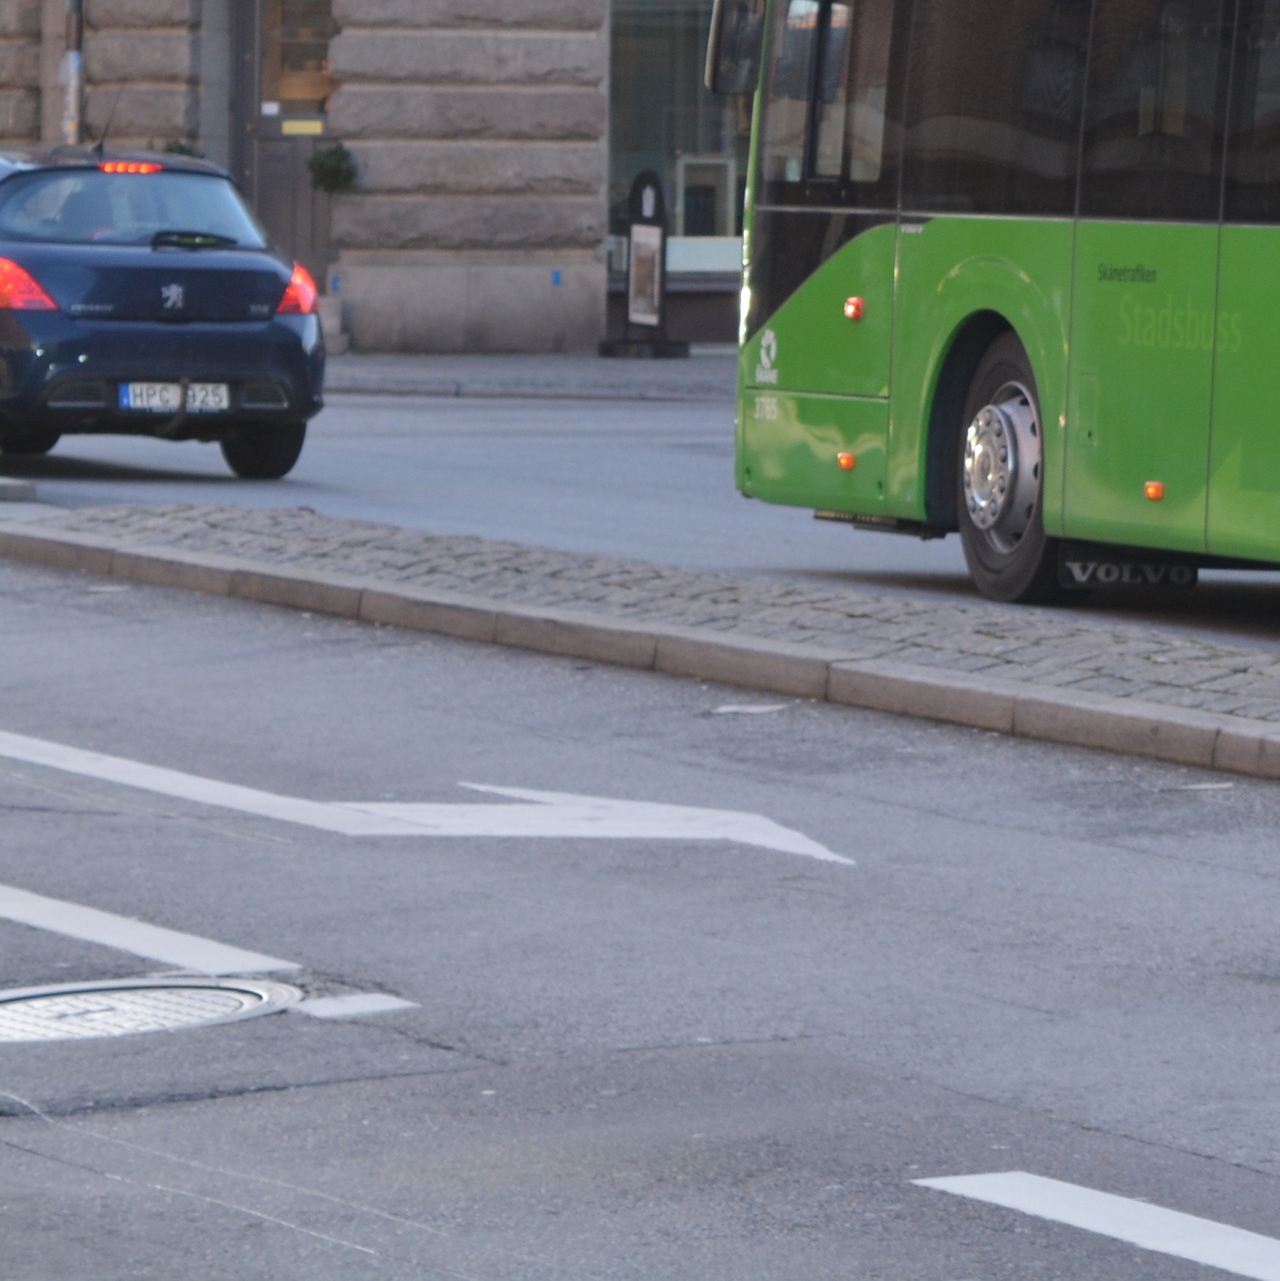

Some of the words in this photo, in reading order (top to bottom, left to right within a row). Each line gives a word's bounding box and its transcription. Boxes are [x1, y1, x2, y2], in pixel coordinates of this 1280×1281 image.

[1118, 294, 1242, 354] Stadsbuss
[131, 385, 170, 401] HPC
[1065, 561, 1193, 586] VOLVO
